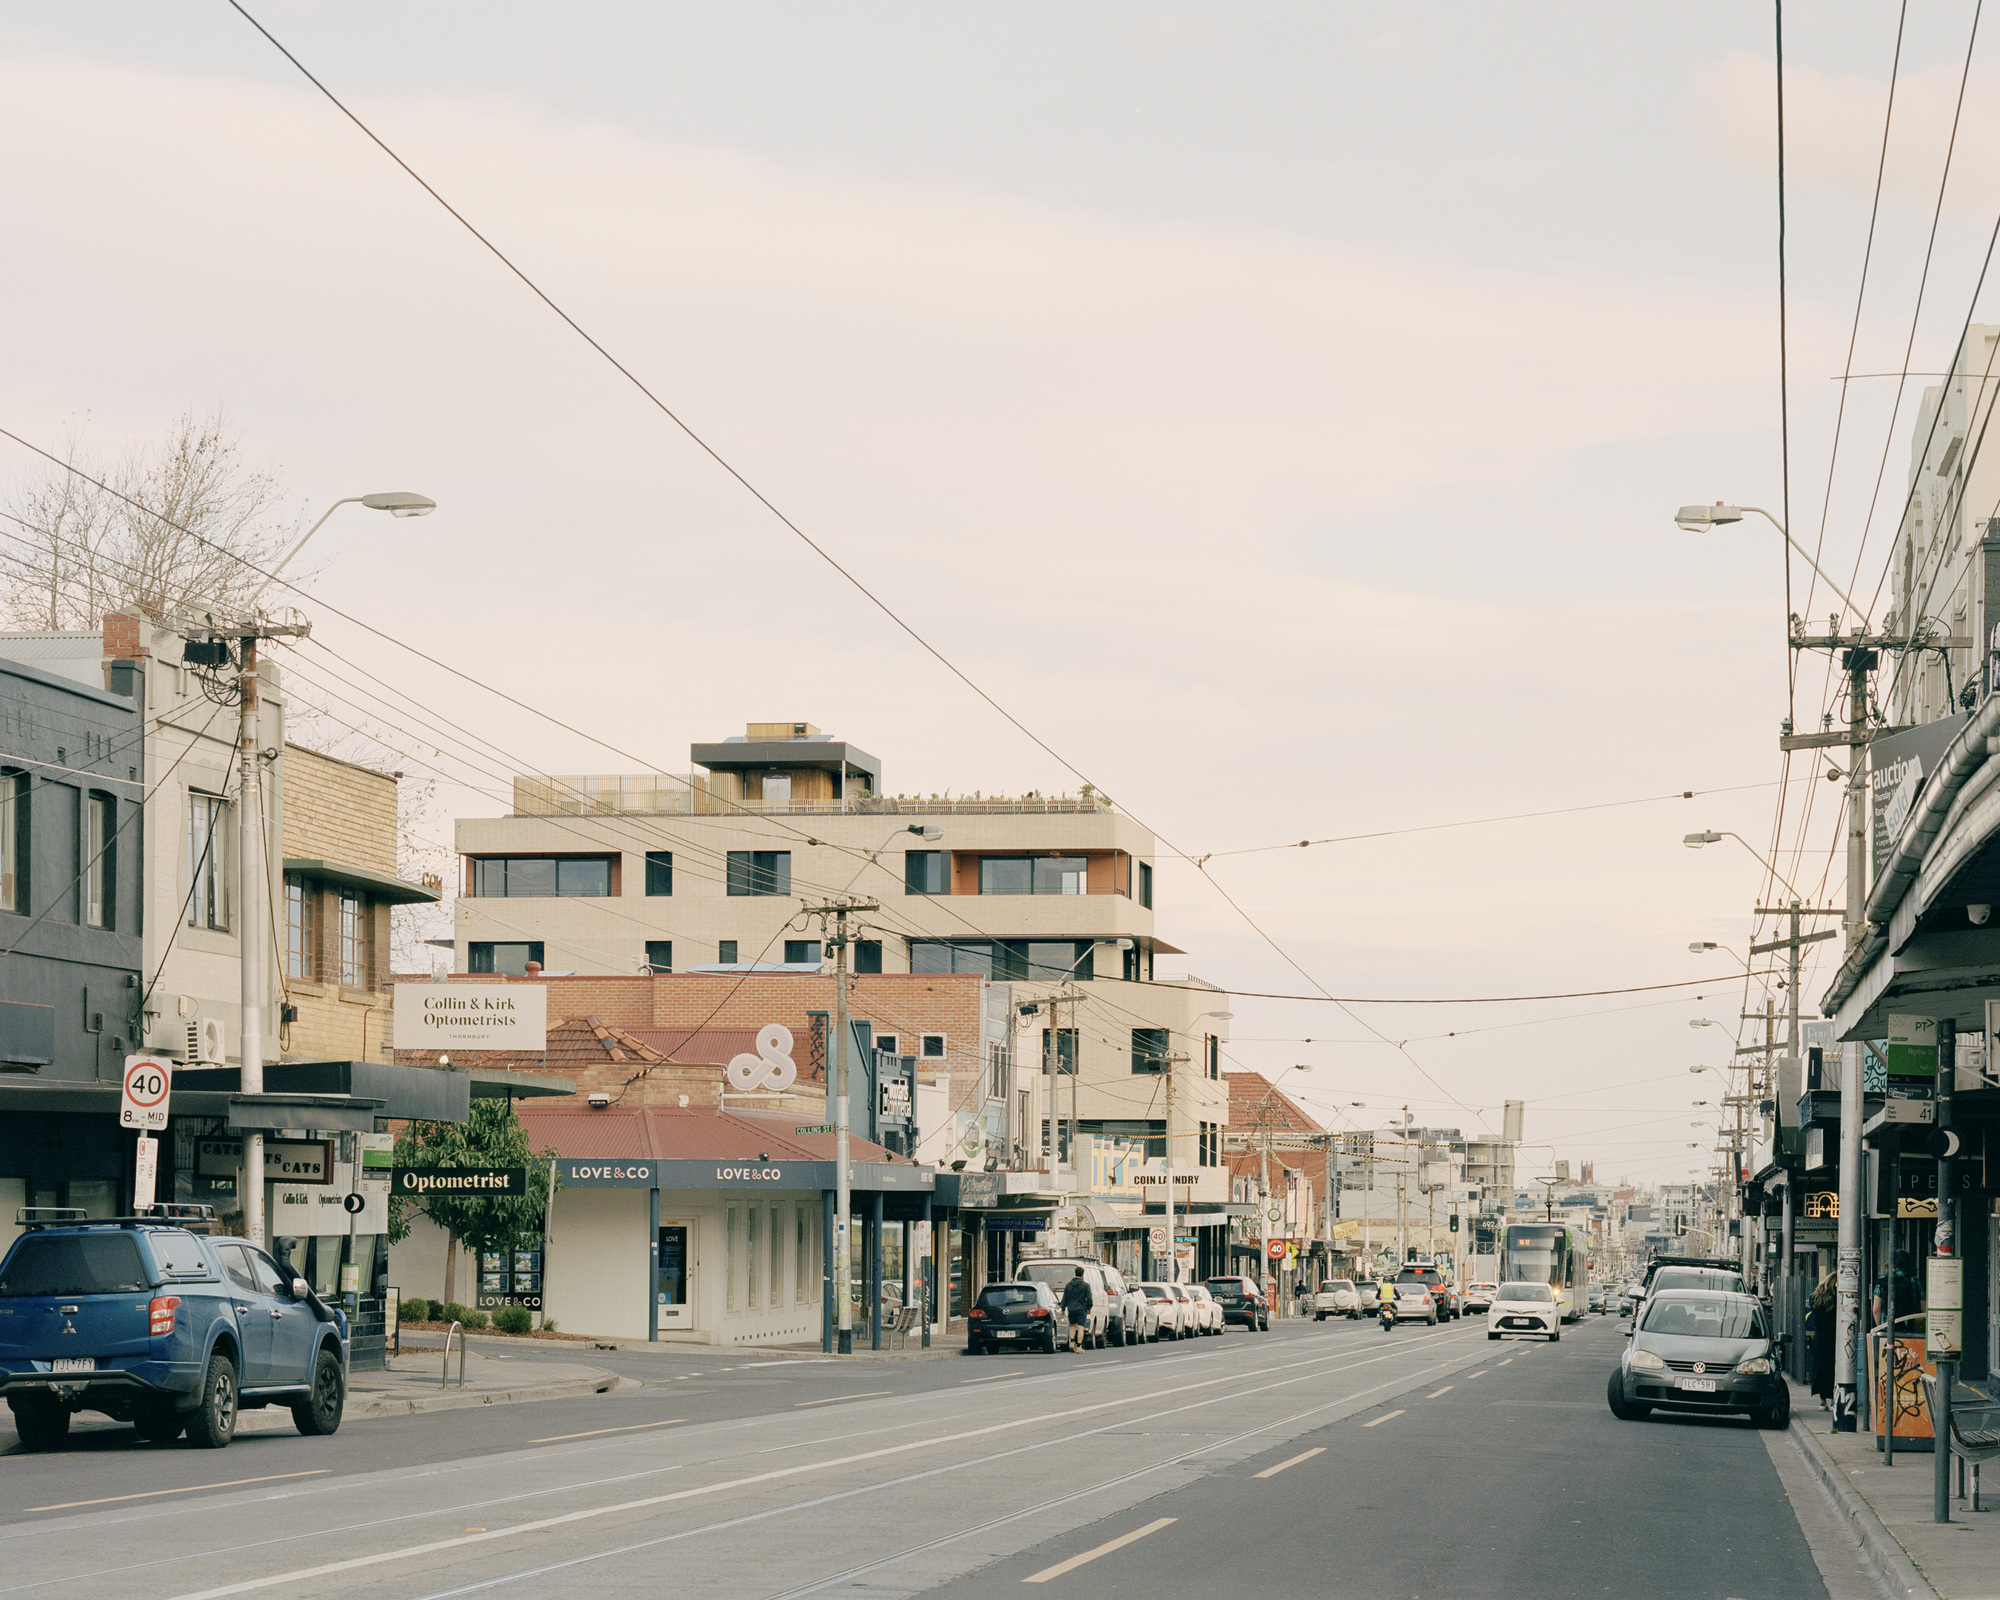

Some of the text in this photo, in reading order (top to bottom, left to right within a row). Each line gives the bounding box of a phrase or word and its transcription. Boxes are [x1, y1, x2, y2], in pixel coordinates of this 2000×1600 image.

[1888, 787, 1909, 835] sold
[424, 997, 516, 1010] Collin & Kirk
[424, 1013, 516, 1028] Optometrists
[132, 1075, 161, 1095] 40
[147, 1112, 165, 1121] MID
[1920, 1108, 1932, 1121] 41
[796, 1125, 831, 1135] COLLINS ST
[202, 1143, 241, 1155] CATS
[264, 1153, 282, 1164] TS
[282, 1162, 321, 1174] CATS
[403, 1172, 510, 1193] Optometrist
[1133, 1175, 1155, 1185] COIN
[283, 1193, 295, 1204] Collin
[300, 1193, 309, 1204] Kirk
[1023, 1218, 1045, 1227] Beauty
[1153, 1233, 1164, 1241] 40
[1270, 1244, 1283, 1254] 40
